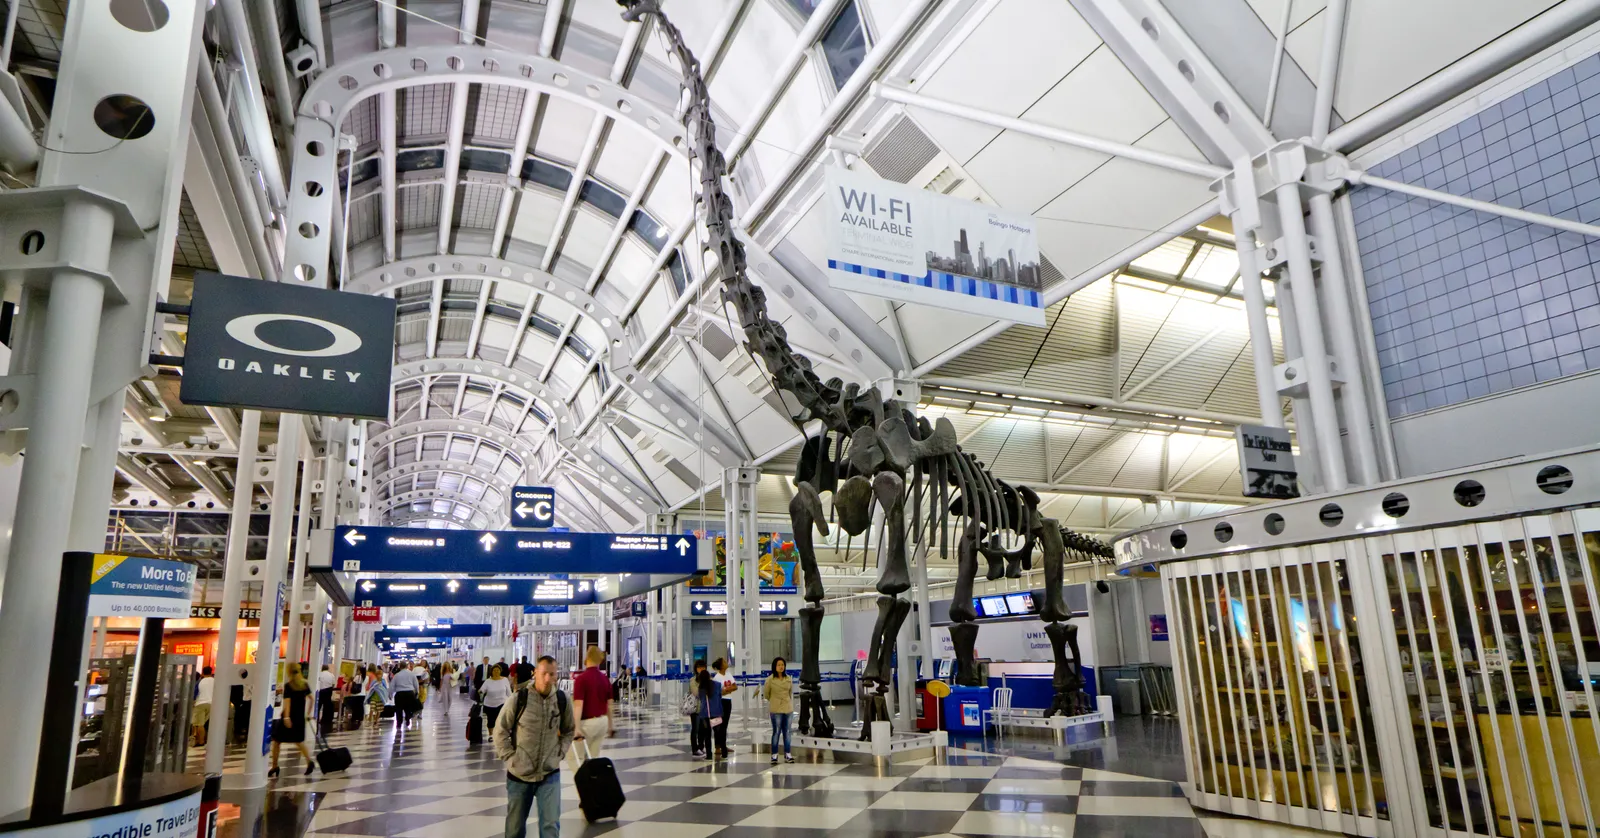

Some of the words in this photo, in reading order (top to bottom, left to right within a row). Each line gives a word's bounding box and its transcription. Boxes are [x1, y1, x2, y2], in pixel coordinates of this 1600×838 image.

[838, 185, 912, 224] WI-FI
[840, 212, 913, 238] AVAILABLE
[217, 357, 362, 383] OAKLEY
[515, 491, 552, 500] Concourse
[534, 501, 552, 520] C
[387, 537, 434, 546] Concourse
[517, 540, 541, 548] Gates
[95, 559, 116, 576] NEW
[141, 565, 174, 581] More
[176, 569, 185, 582] To
[111, 581, 126, 589] The
[143, 583, 164, 591] United
[111, 604, 122, 613] Up
[133, 605, 156, 613] 40,000
[356, 609, 378, 617] FREE
[156, 810, 187, 833] Travel
